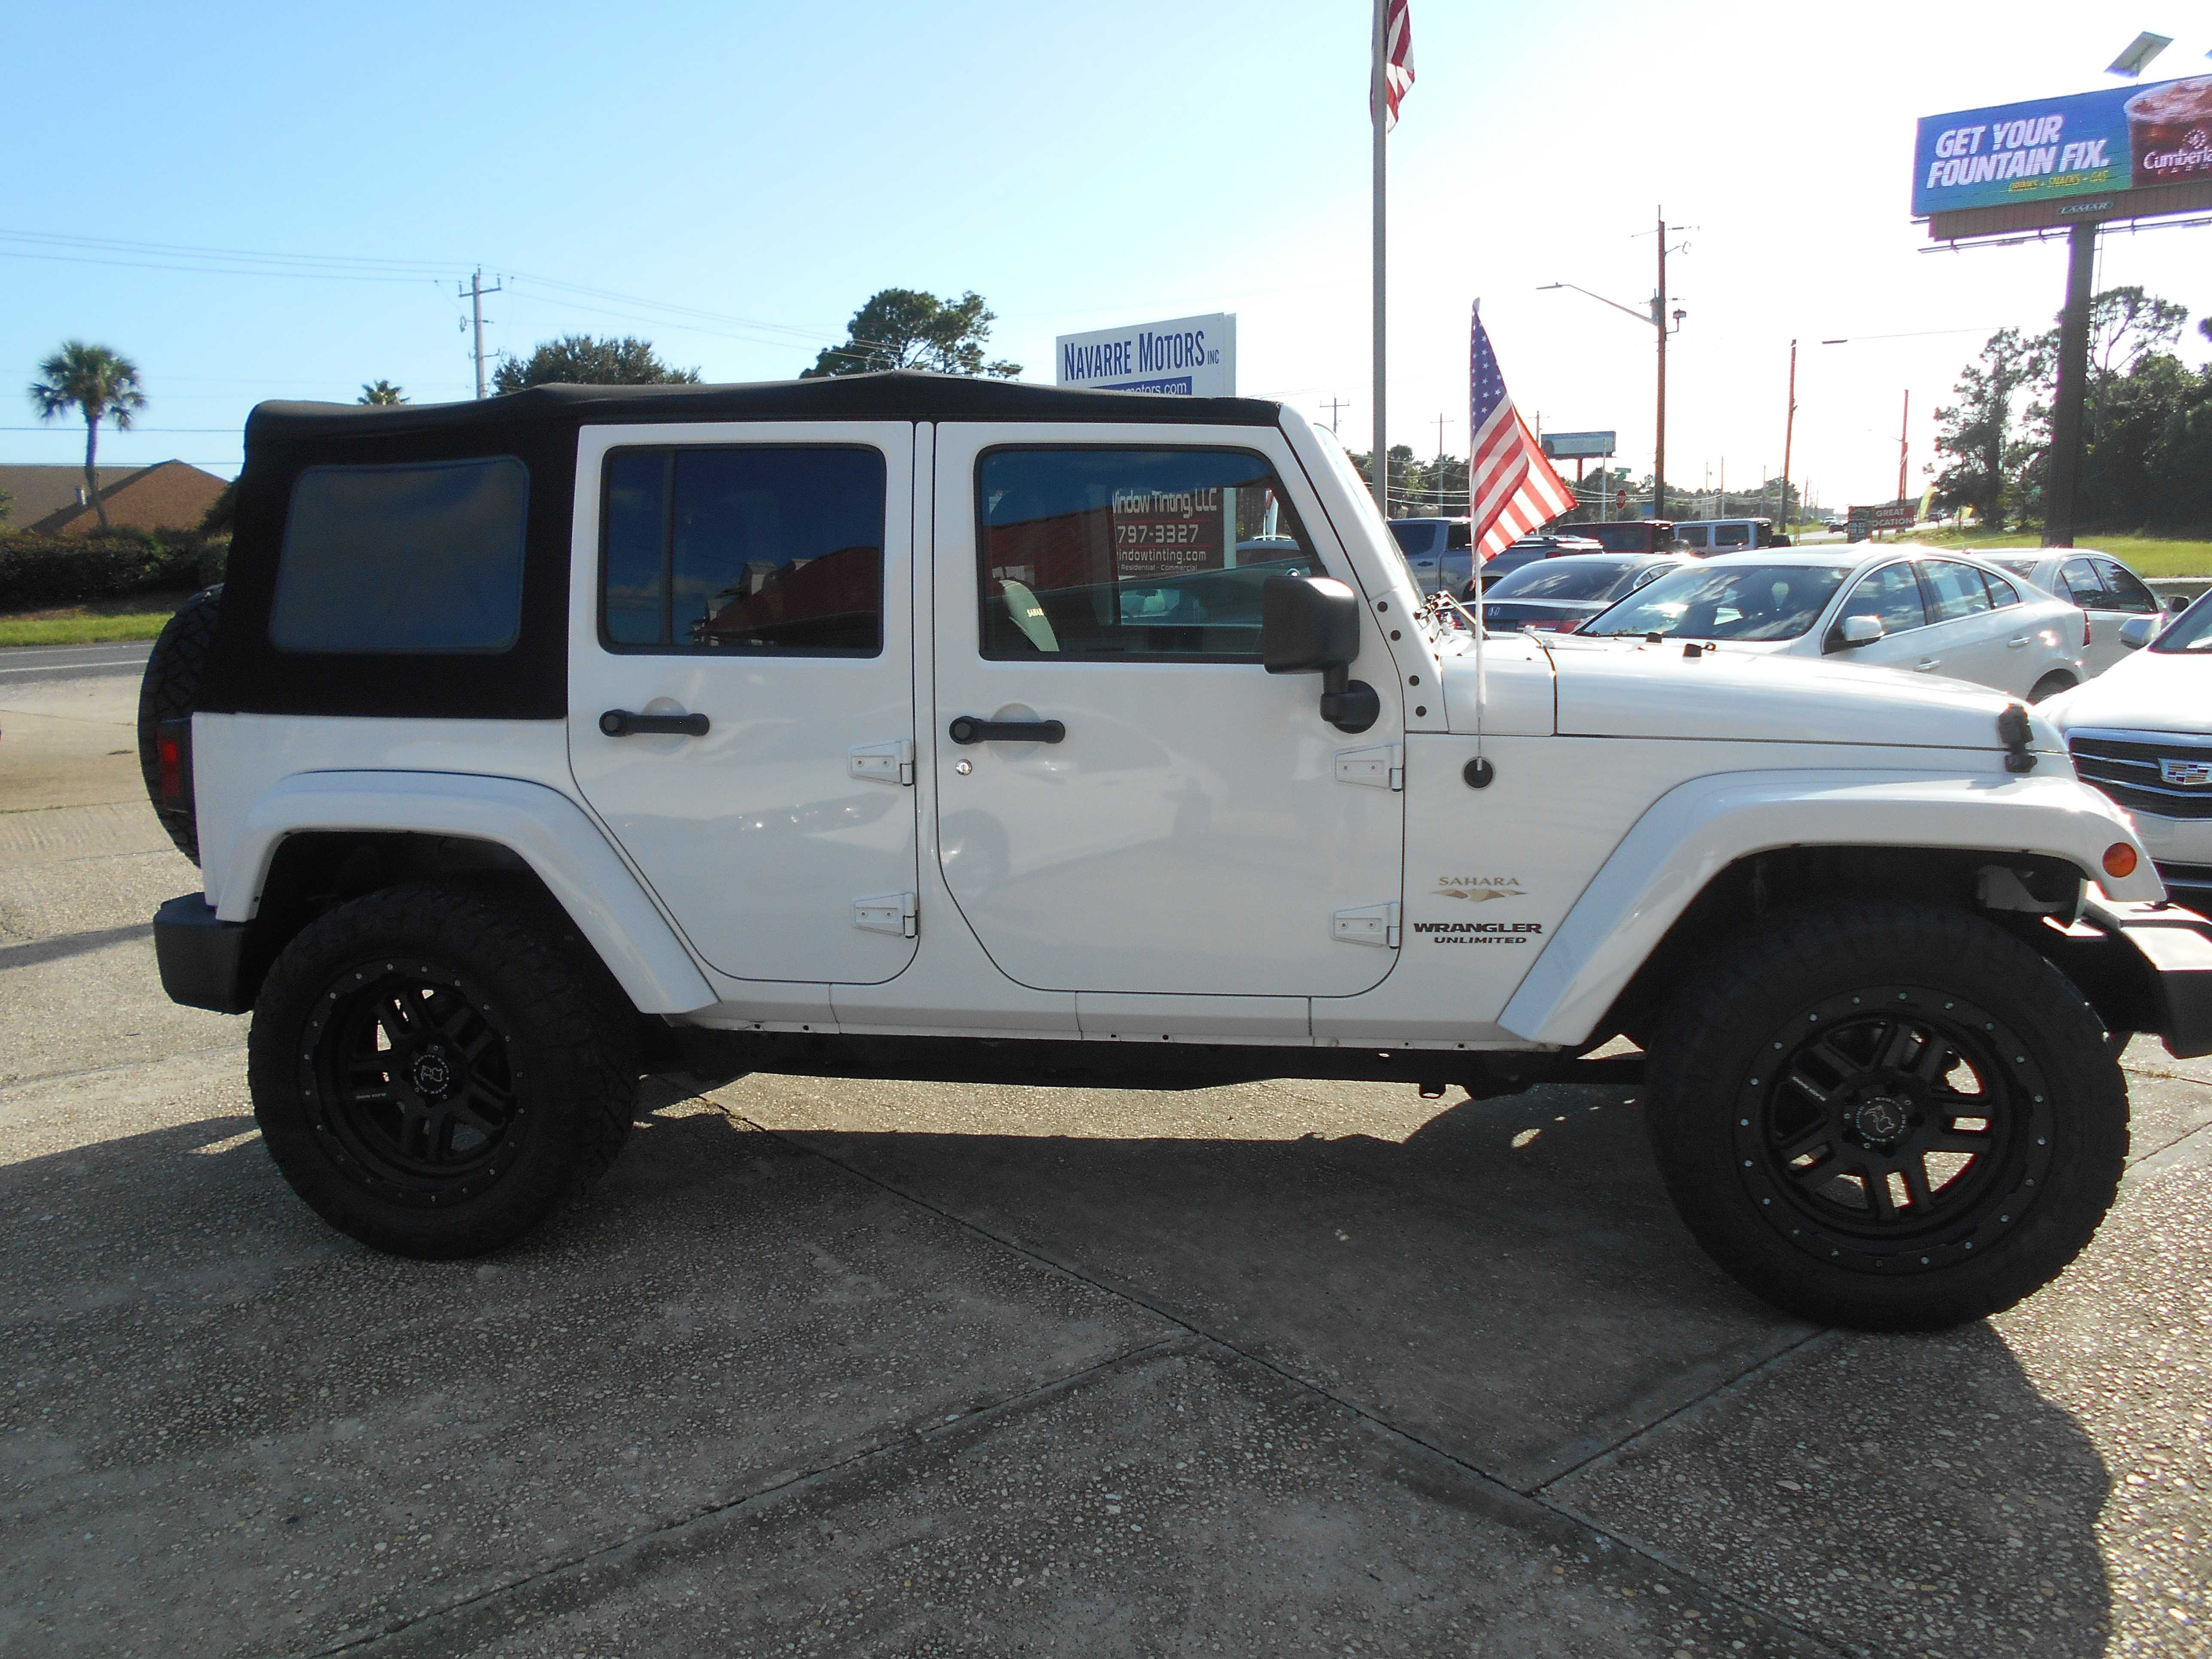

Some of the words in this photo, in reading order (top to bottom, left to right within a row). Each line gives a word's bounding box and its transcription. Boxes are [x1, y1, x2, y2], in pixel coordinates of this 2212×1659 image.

[1936, 126, 1986, 158] GET
[1992, 115, 2063, 150] YOUR
[1926, 146, 2057, 189] FOUNTAIN
[2061, 140, 2109, 173] FIX.
[2061, 202, 2108, 214] LAMAR
[1064, 340, 1132, 381] NAVARRE
[1139, 330, 1205, 373] MOTORS
[1207, 349, 1219, 365] INC
[1195, 488, 1217, 511] LLC
[1876, 508, 1905, 517] GREAT
[1872, 517, 1912, 527] OCATION
[1117, 524, 1199, 544] 797-3327
[1117, 548, 1206, 565] indowtinting.com
[1027, 608, 1045, 618] SAHAR
[1439, 877, 1519, 885] SAHARA
[1413, 923, 1542, 934] WRANGLER
